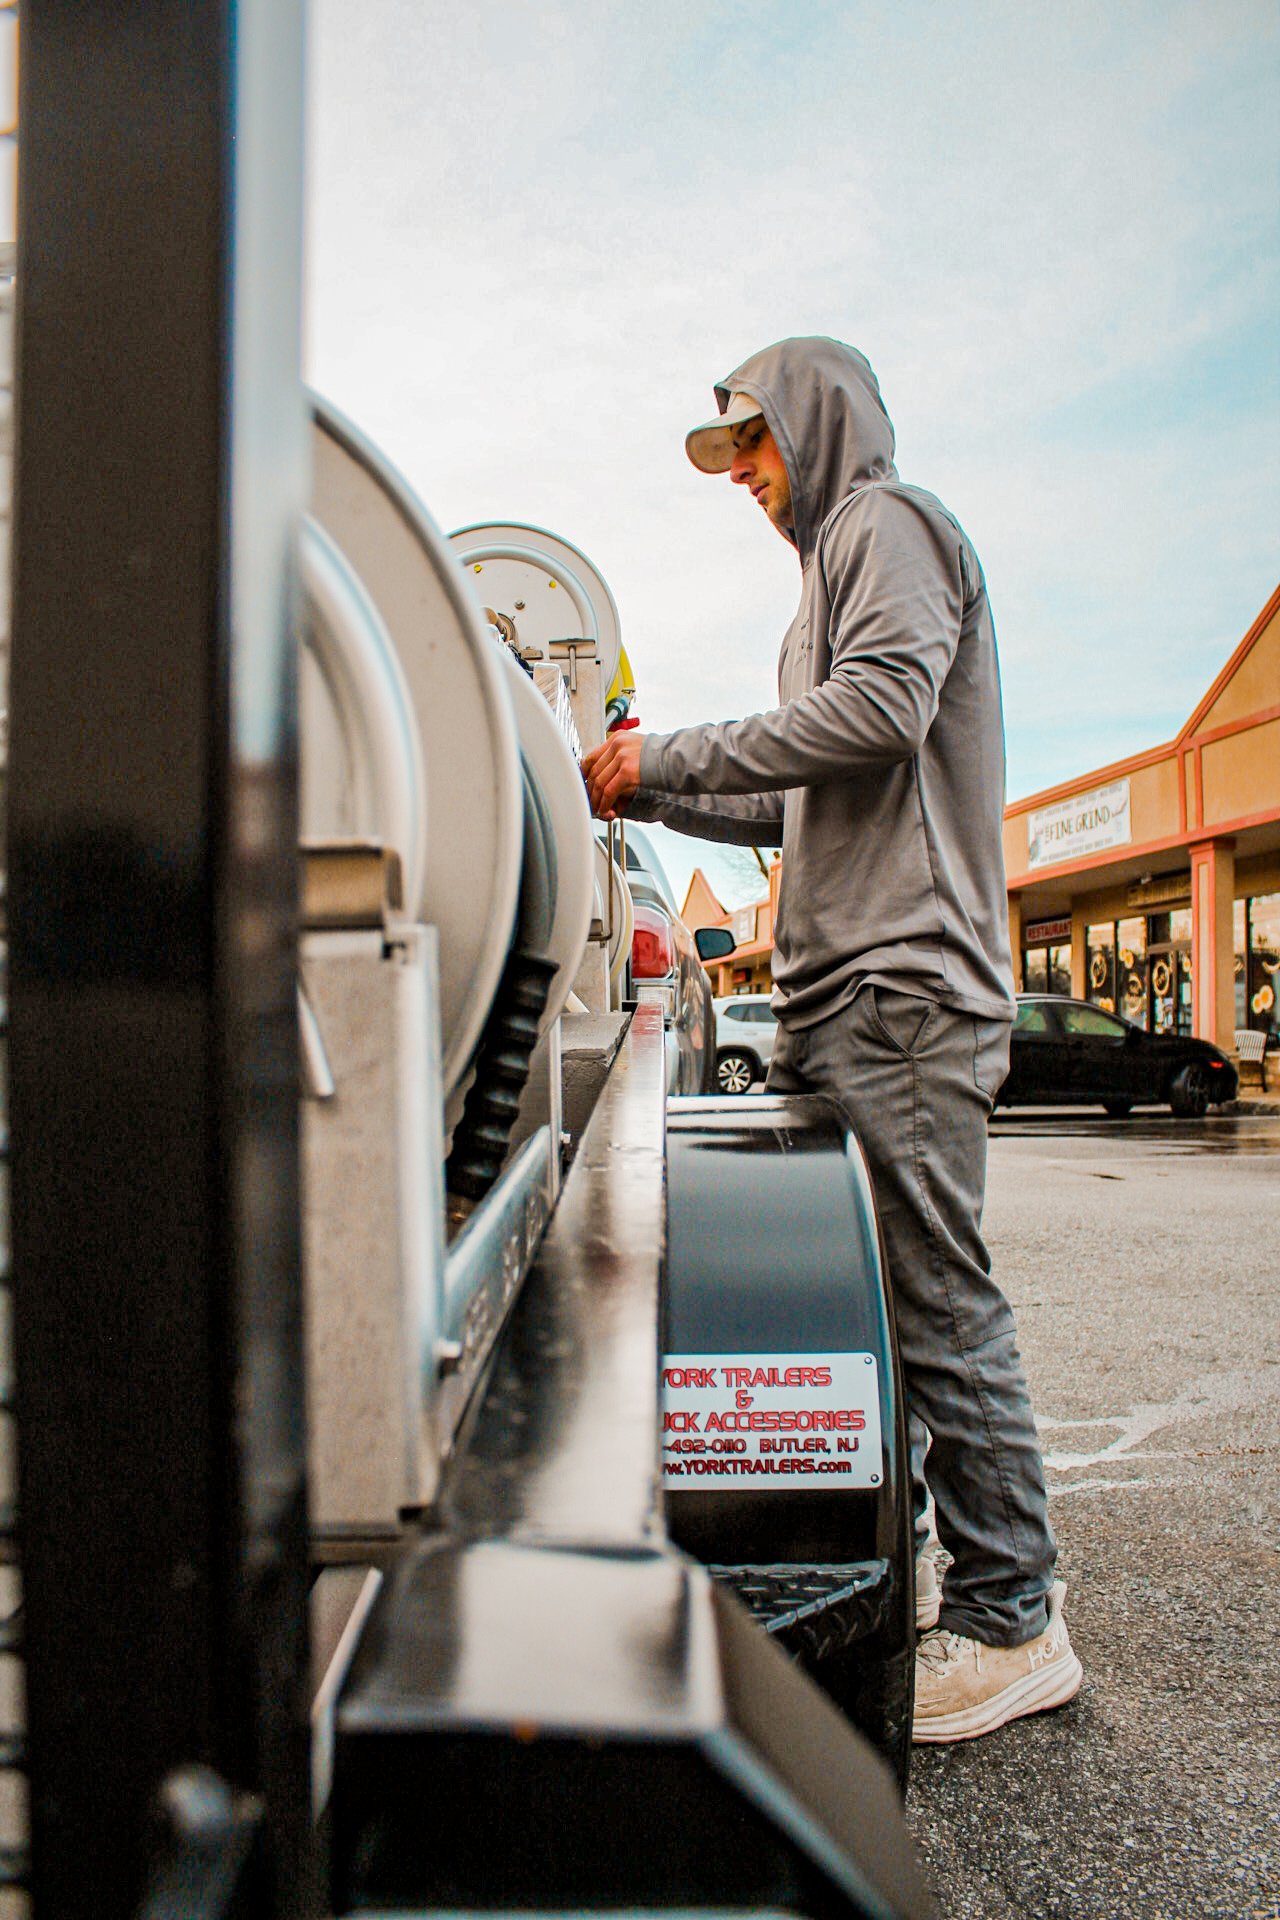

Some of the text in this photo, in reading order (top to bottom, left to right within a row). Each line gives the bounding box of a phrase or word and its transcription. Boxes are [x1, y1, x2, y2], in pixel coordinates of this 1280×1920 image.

[1049, 805, 1110, 841] FINE GRIND
[1028, 920, 1072, 940] RESTAURANT
[721, 1367, 832, 1388] TRAILERS
[735, 1390, 754, 1409] &
[704, 1410, 866, 1433] ACCESSORIES
[759, 1438, 831, 1455] BUTLER,
[837, 1437, 860, 1453] NJ
